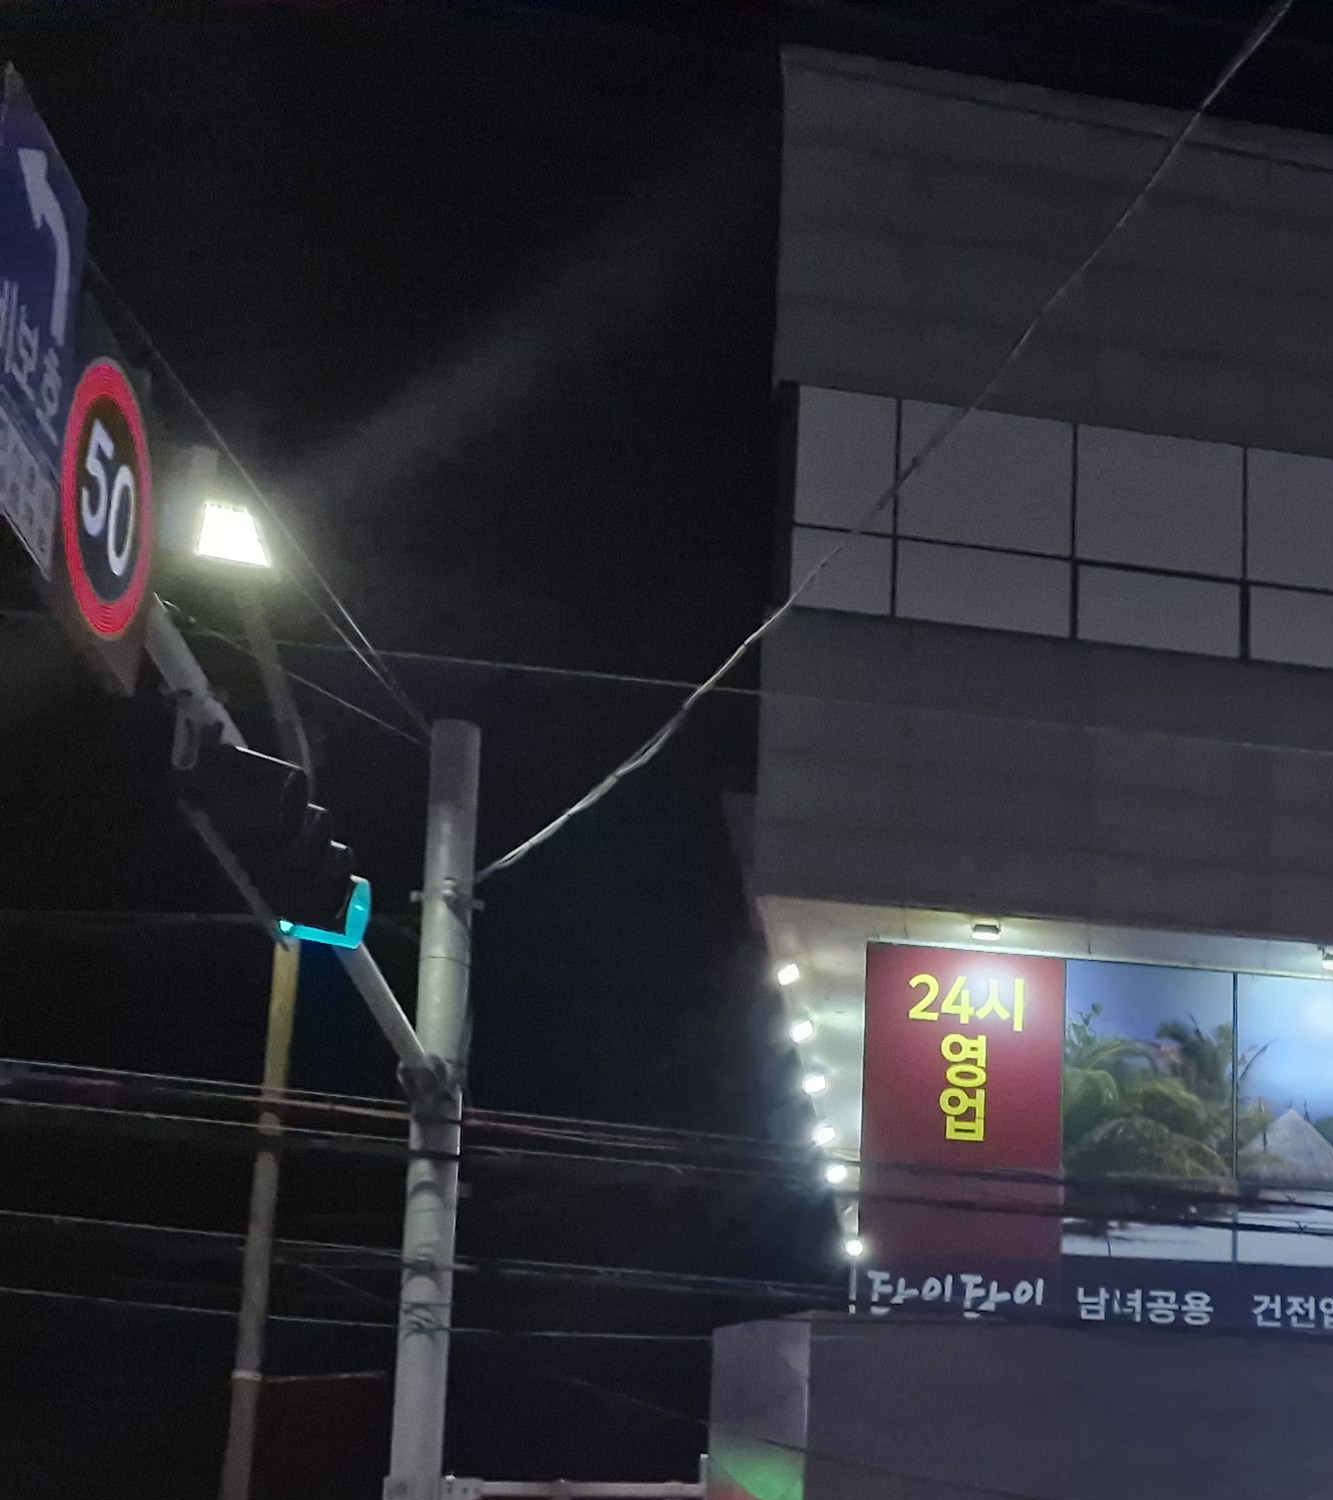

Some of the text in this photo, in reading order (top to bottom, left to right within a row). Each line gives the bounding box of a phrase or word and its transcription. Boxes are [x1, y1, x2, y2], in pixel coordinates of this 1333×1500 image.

[81, 418, 136, 578] 50
[908, 973, 1026, 1032] 24시
[938, 1033, 989, 1142] 영업
[1076, 1286, 1215, 1327] 남녀공용
